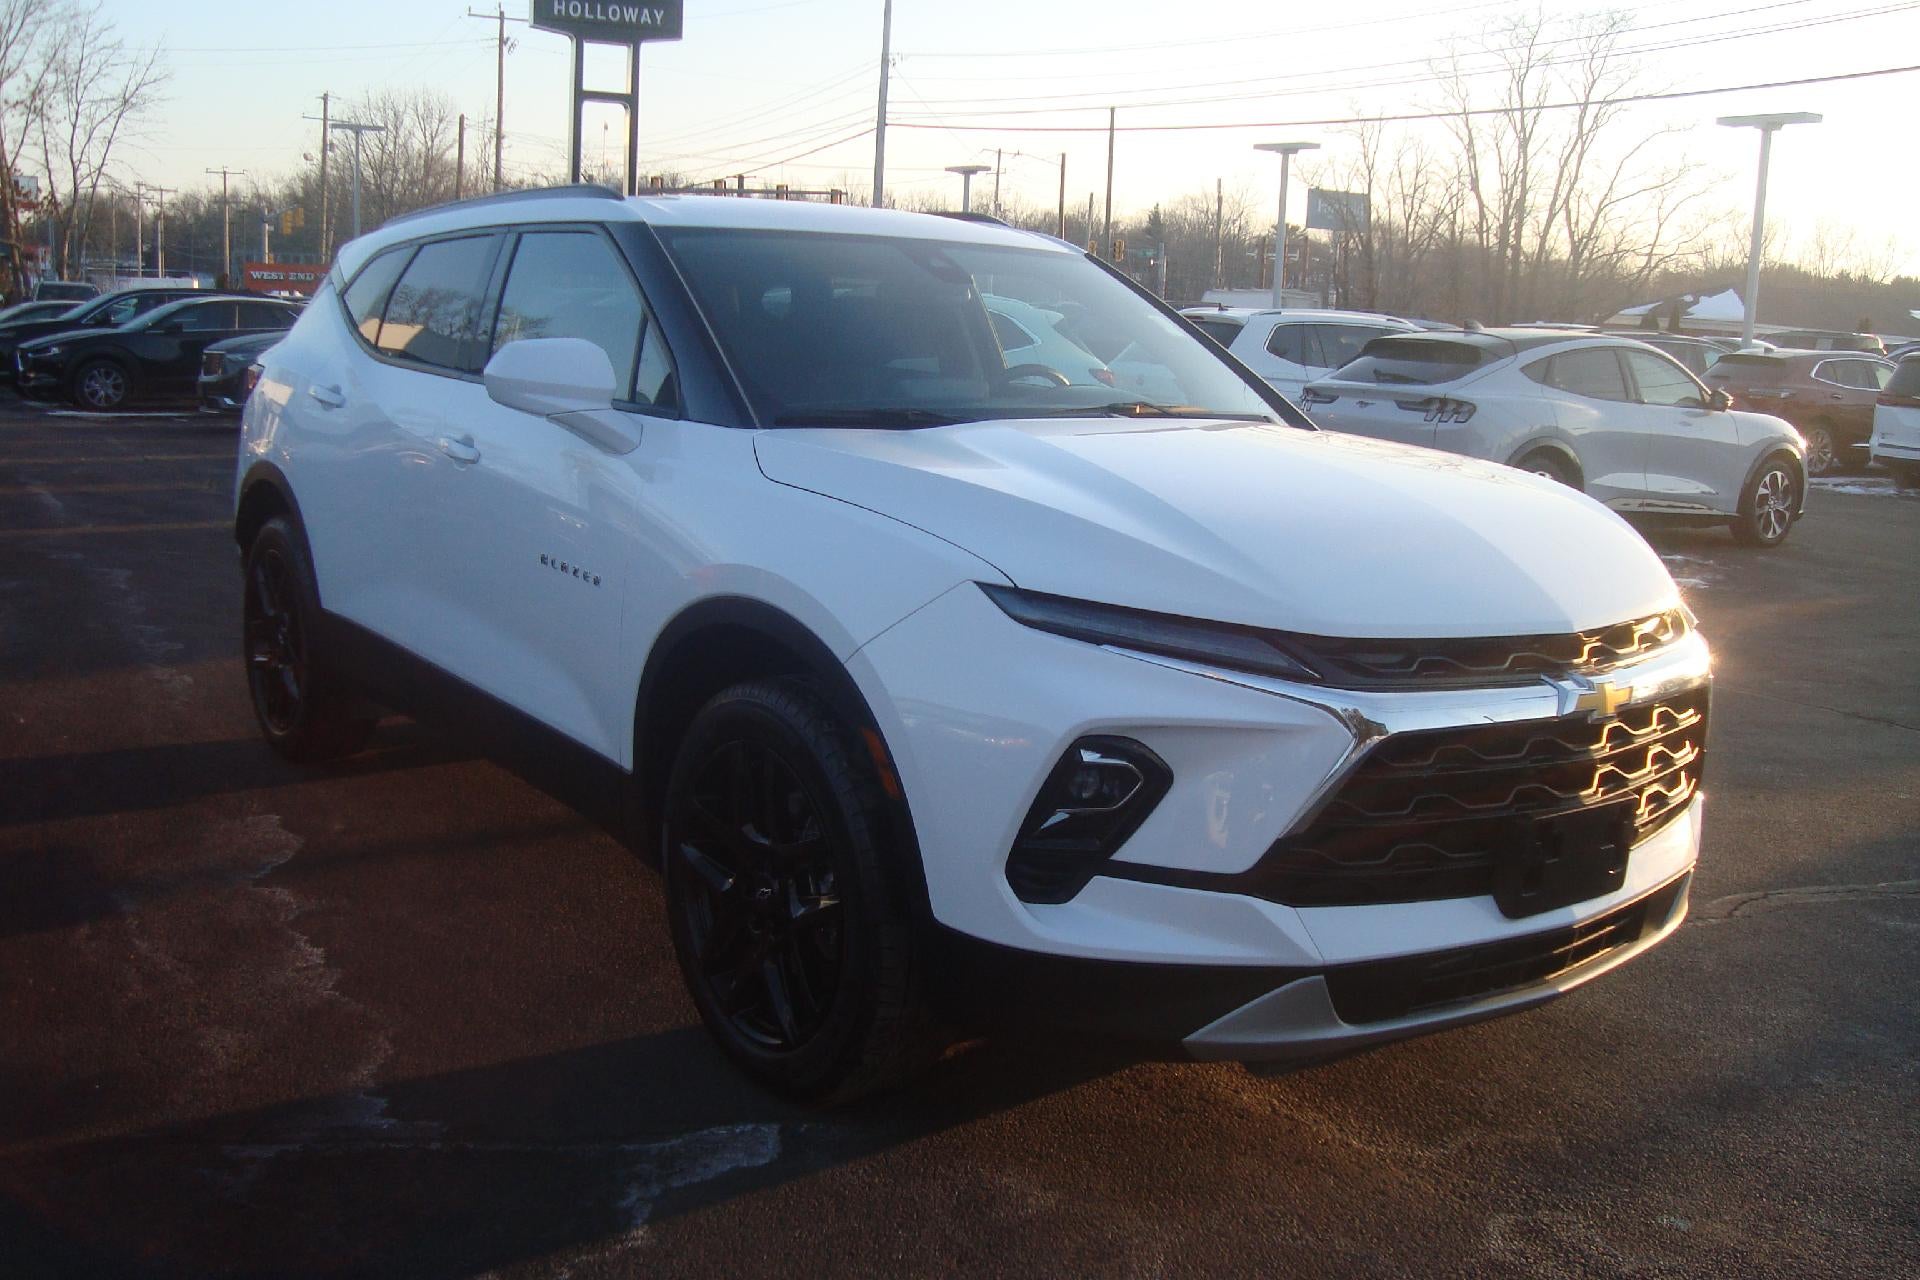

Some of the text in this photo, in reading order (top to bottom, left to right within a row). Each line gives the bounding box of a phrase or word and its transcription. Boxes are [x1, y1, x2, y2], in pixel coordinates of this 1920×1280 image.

[553, 0, 664, 25] HOLLOWAY
[250, 271, 285, 280] WEST
[288, 272, 315, 280] END
[540, 553, 601, 586] BLAZER
